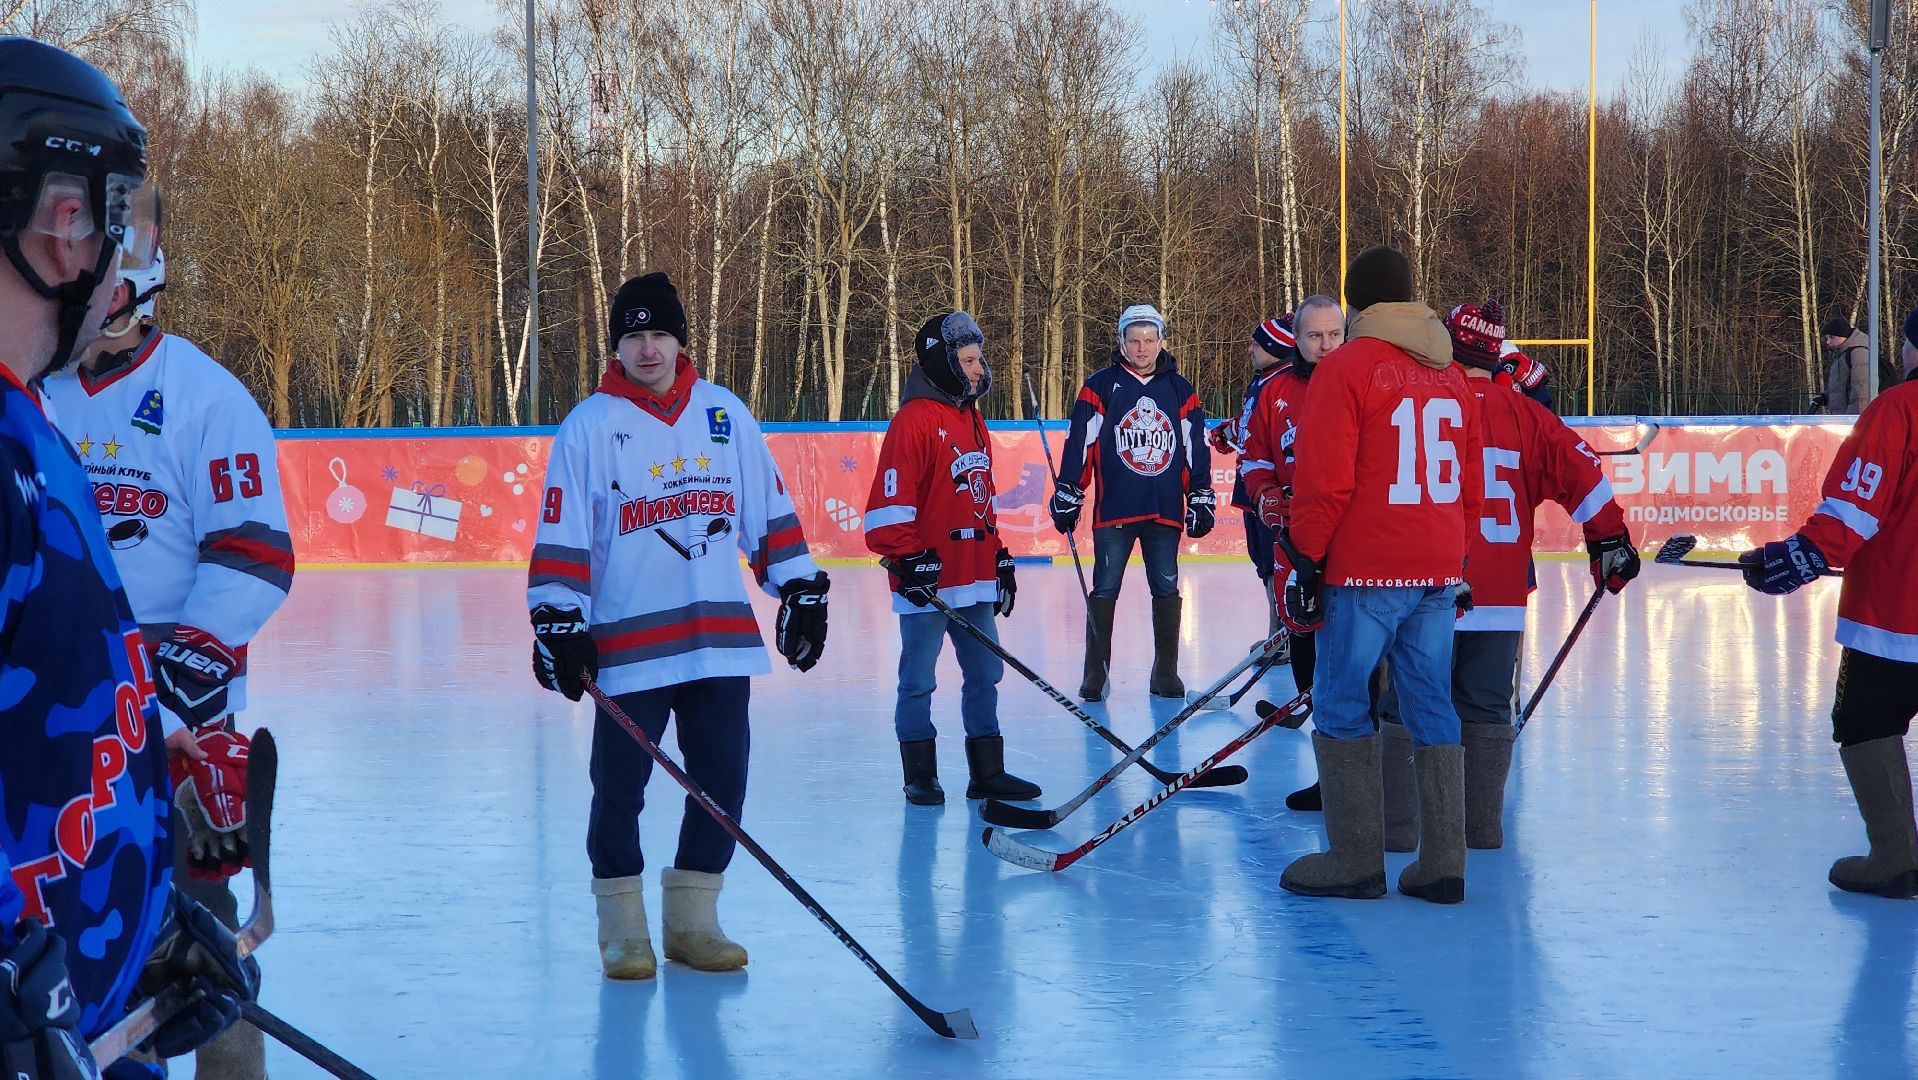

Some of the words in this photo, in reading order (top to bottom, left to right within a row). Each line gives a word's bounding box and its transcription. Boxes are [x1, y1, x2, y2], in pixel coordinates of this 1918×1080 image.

[1389, 398, 1462, 504] 16
[118, 467, 152, 480] КЛУБ
[209, 453, 263, 504] 63
[884, 468, 897, 498] 8
[1610, 449, 1787, 495] ЗИМА
[1840, 456, 1883, 500] 99
[543, 487, 563, 524] 9
[1629, 505, 1787, 524] ПОДМОСКОВЬЕ
[535, 621, 588, 634] CCM
[156, 641, 229, 680] AUER
[1092, 757, 1214, 847] SALMING
